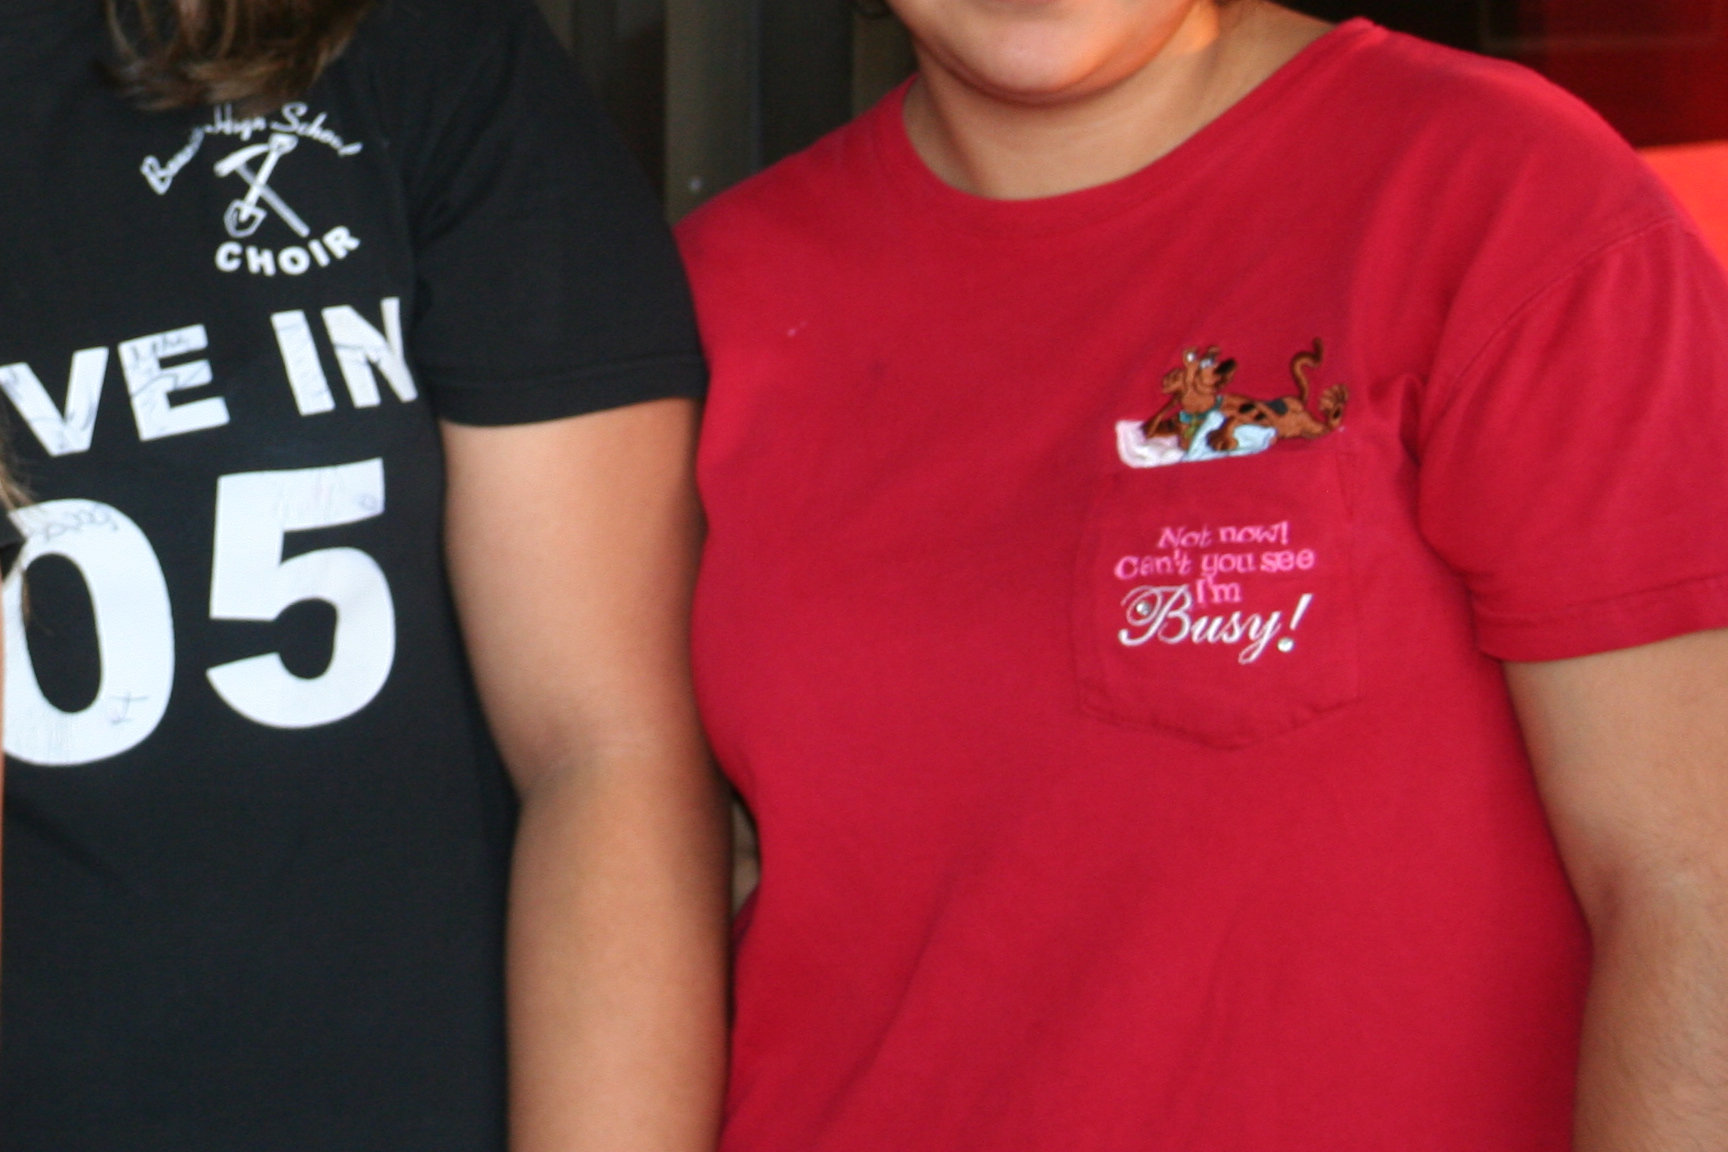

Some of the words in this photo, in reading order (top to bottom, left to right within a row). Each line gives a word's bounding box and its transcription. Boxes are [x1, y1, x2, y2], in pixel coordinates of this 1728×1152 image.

[215, 226, 361, 276] CHOIR
[271, 297, 418, 417] IN
[1158, 526, 1212, 549] Not
[1219, 520, 1290, 545] now!
[1114, 550, 1192, 580] Can't
[1201, 551, 1256, 578] you
[1260, 549, 1316, 571] see
[1, 458, 396, 766] 05
[1195, 576, 1241, 606] I'm
[1118, 585, 1313, 665] Busy!
